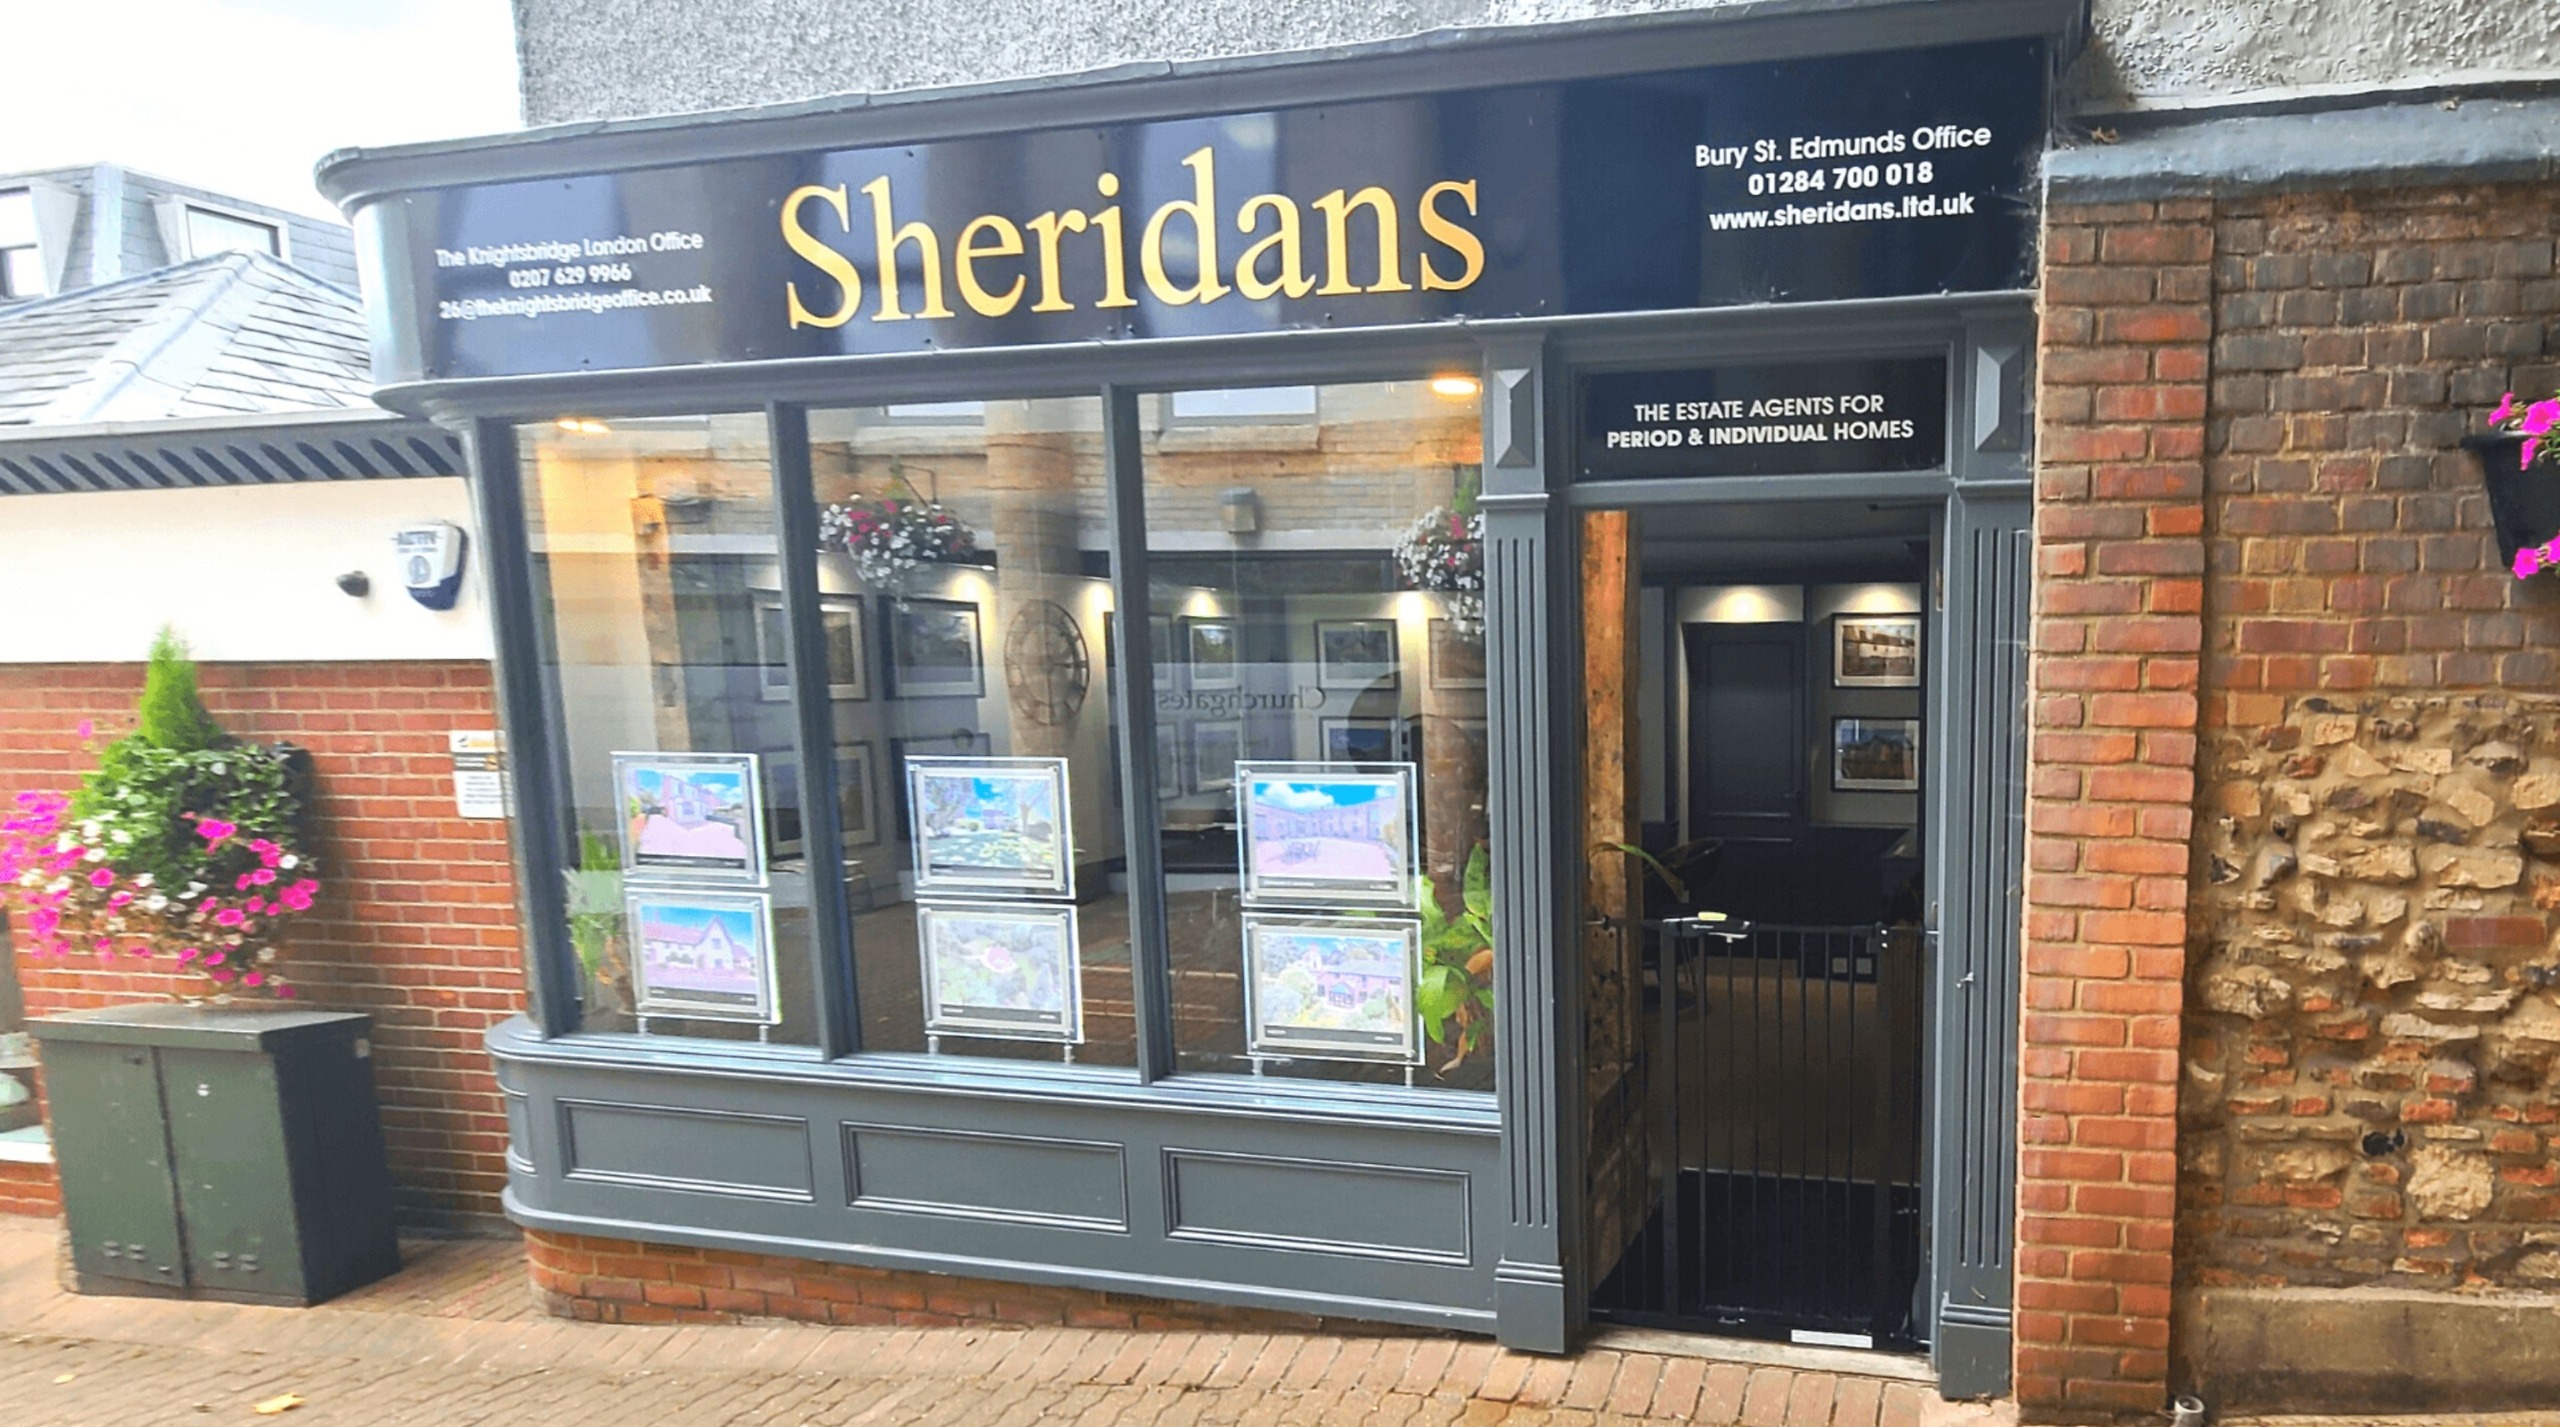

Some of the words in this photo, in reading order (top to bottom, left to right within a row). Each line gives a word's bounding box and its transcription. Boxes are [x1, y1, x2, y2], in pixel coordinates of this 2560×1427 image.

[1695, 144, 1748, 168] Bury
[1754, 140, 1782, 163] St.
[1790, 130, 1905, 160] Edmunds
[1912, 125, 1991, 150] Office
[1748, 168, 1825, 195] 01284
[1832, 164, 1879, 190] 700
[1885, 161, 1934, 185] 018
[1709, 192, 1975, 230] www.sheridans.ltd.uk
[435, 248, 466, 267] The
[468, 239, 581, 268] Knightsbridge
[584, 236, 648, 257] London
[650, 231, 704, 251] Office
[779, 146, 1486, 330] Sheridans
[509, 268, 551, 288] 0207
[554, 266, 586, 285] 629
[589, 263, 632, 283] 9966
[439, 285, 712, 320] 26@theknightsbridgeoffice.co.uk
[1634, 403, 1670, 422] THE
[1676, 400, 1743, 421] ESTATE
[1749, 396, 1834, 418] AGENTS
[1840, 394, 1884, 414] FOR
[1607, 428, 1682, 449] PERIOD
[1688, 428, 1704, 446] &
[1709, 424, 1828, 445] INDIVIDUAL
[1834, 420, 1914, 441] HOMES
